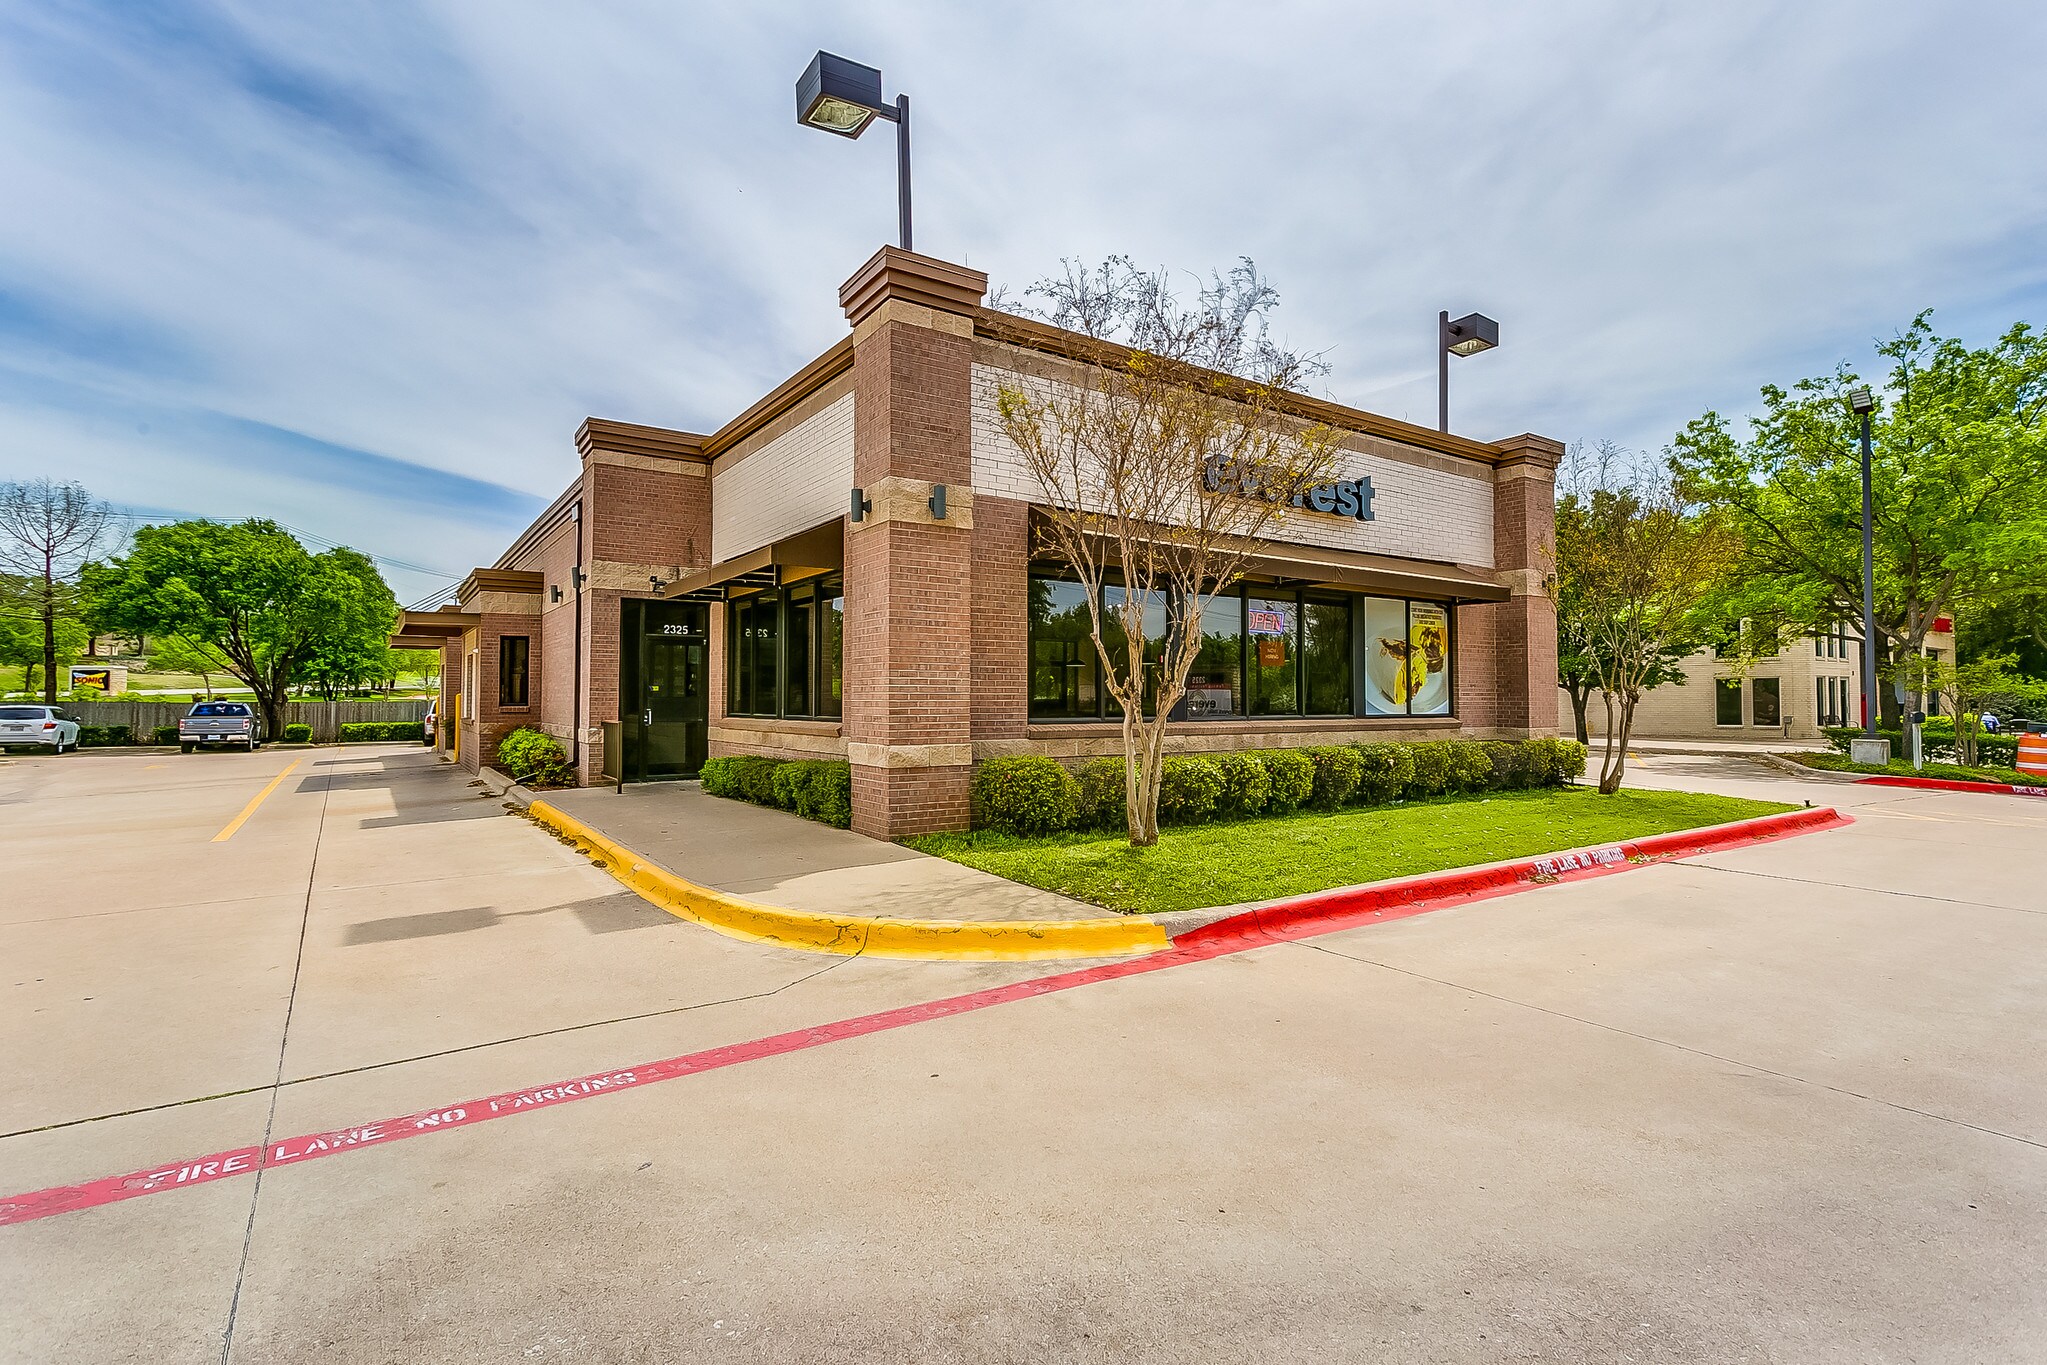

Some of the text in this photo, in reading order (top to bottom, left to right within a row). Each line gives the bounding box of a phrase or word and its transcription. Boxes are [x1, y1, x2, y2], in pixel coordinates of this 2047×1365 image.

[1203, 453, 1376, 521] eest
[663, 624, 689, 635] 2325
[74, 677, 104, 685] SONIC
[1534, 847, 1626, 875] FIRE LANE NO PARKING
[143, 1071, 637, 1189] FIRE LANE NO PARKING
